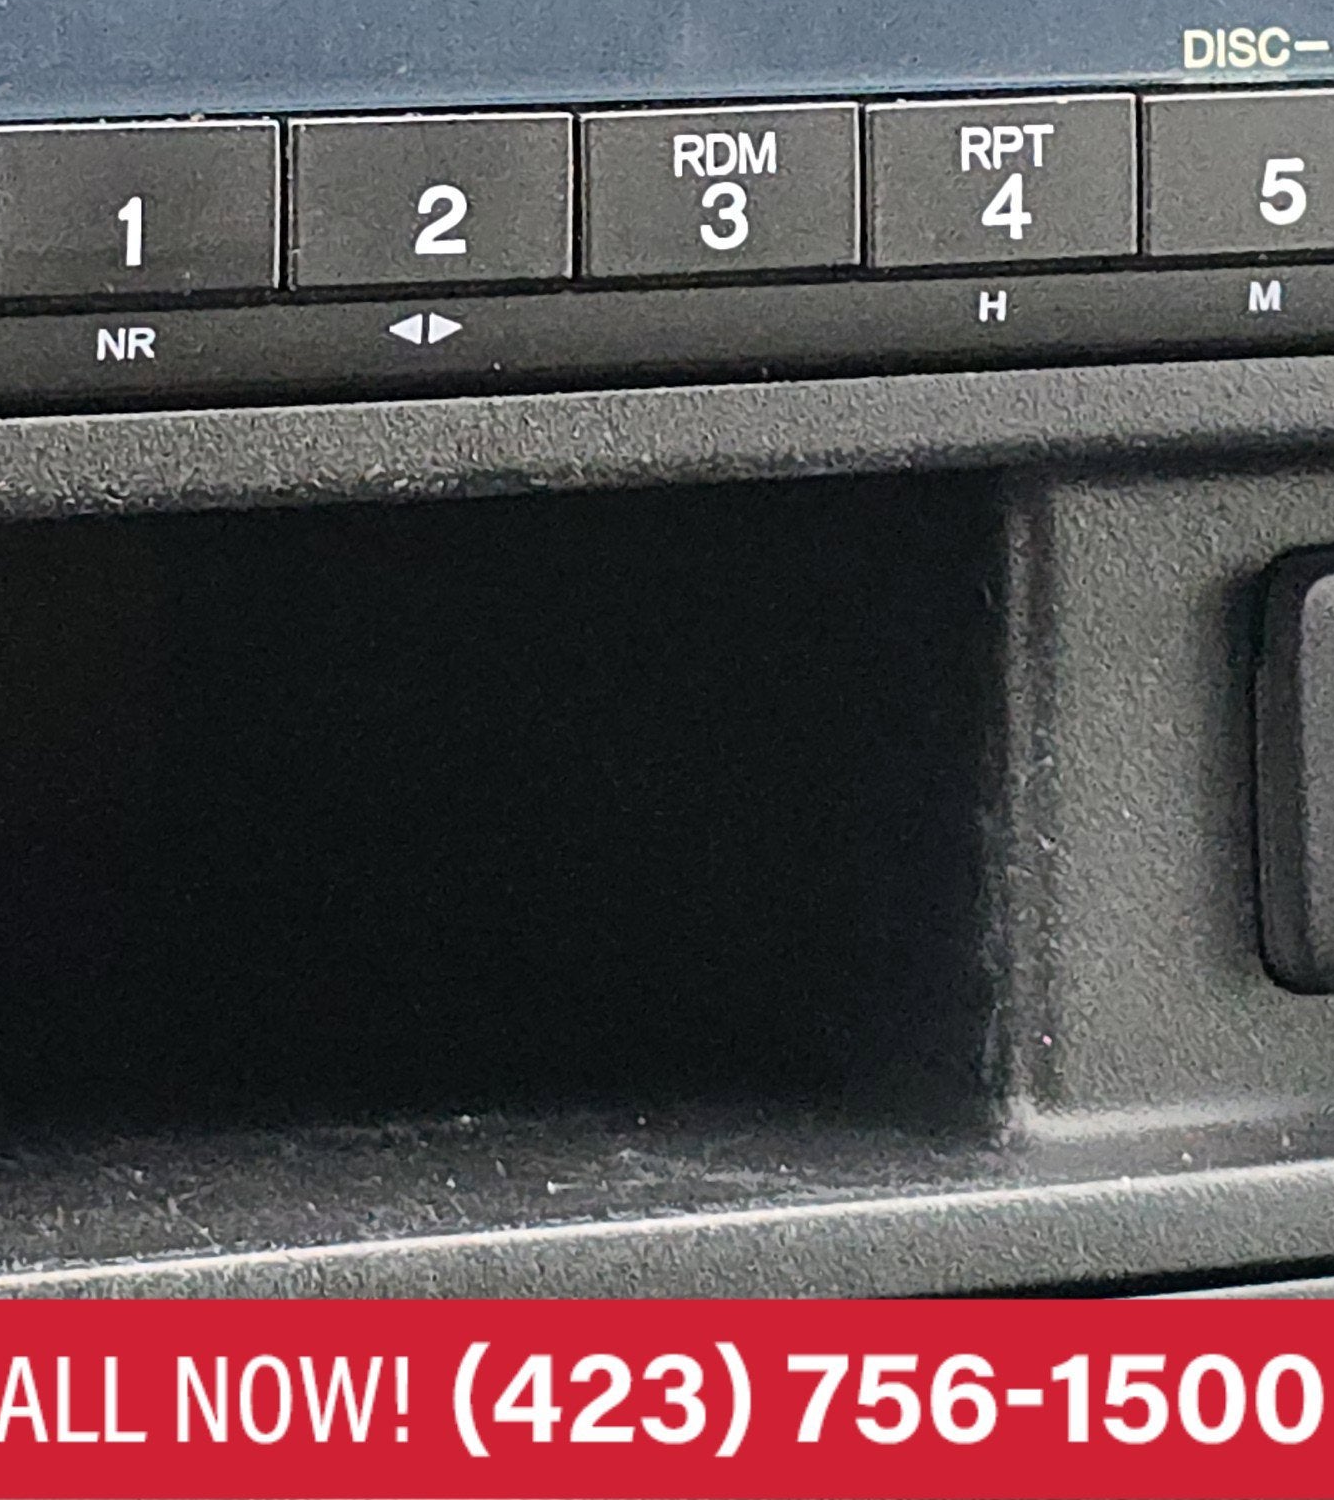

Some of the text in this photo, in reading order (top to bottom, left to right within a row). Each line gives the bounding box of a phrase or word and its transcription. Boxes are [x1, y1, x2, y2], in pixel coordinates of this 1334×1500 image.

[673, 131, 777, 178] RDM
[961, 123, 1055, 172] RPT
[414, 184, 468, 255] 2
[700, 181, 749, 250] 3
[981, 172, 1032, 240] 4
[1259, 157, 1307, 226] 5
[117, 196, 142, 266] 1
[979, 290, 1007, 322] H
[1248, 280, 1281, 312] M
[96, 327, 156, 361] NR
